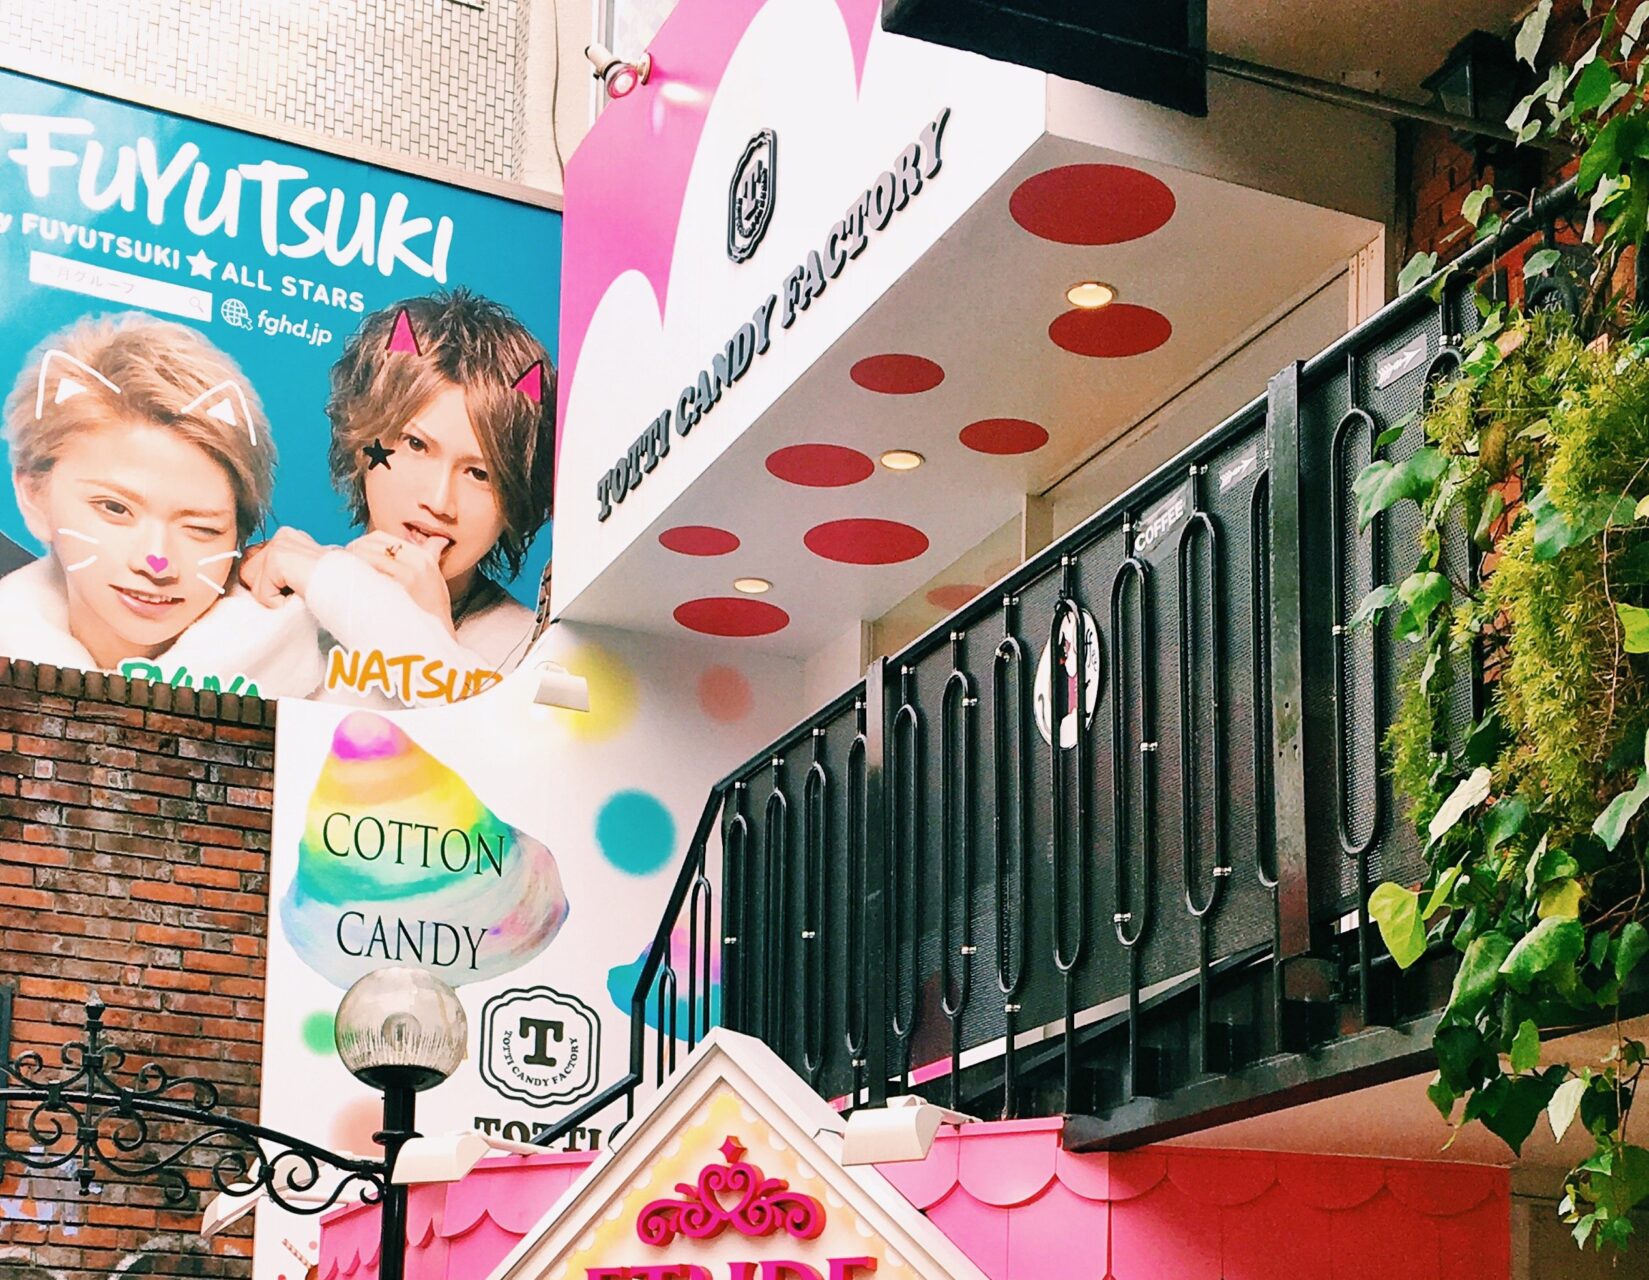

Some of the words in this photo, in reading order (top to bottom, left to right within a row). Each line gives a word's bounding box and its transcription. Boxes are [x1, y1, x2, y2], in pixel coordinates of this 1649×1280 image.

[22, 214, 180, 270] FUYUTSUKI
[222, 262, 272, 292] ALL
[281, 276, 365, 312] STARS
[257, 310, 332, 346] fghd.jp
[598, 409, 671, 522] TOTTI
[675, 294, 777, 437] CANDY
[781, 107, 951, 329] FACTORY
[1134, 499, 1184, 552] COFFEE
[323, 812, 505, 877] COTTON
[336, 911, 488, 970] CANDY
[502, 1030, 514, 1066] TOTTI
[512, 1065, 550, 1087] CANDY
[552, 1037, 579, 1085] FACTORY
[519, 1016, 564, 1067] T
